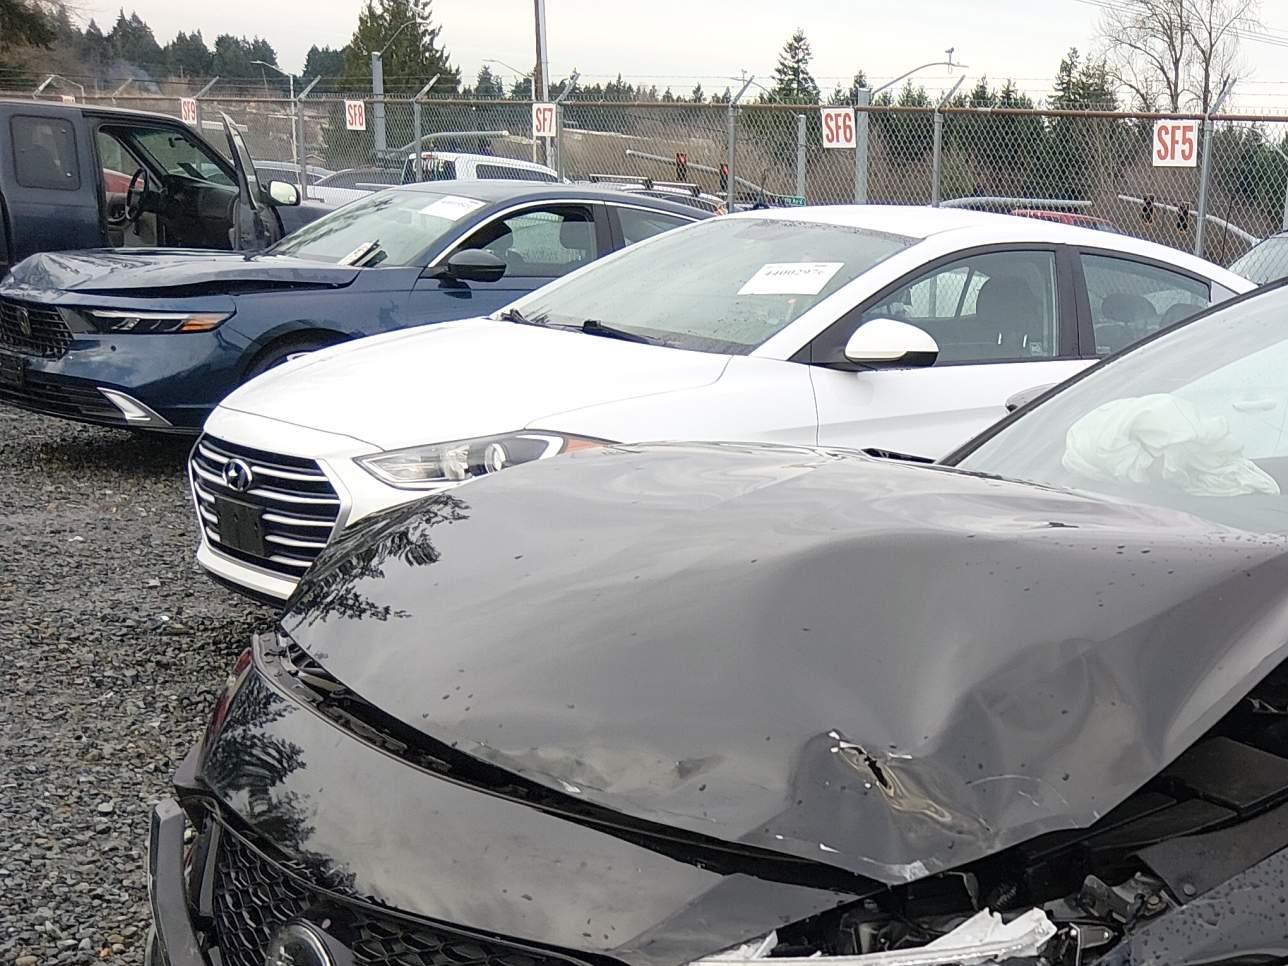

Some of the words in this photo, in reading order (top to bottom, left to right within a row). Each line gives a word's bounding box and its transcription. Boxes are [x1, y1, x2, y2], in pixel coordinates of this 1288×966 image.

[181, 101, 196, 120] SF9
[347, 104, 364, 127] SF8
[535, 107, 554, 133] SF7
[824, 113, 853, 143] SF6
[1156, 125, 1194, 161] SF5
